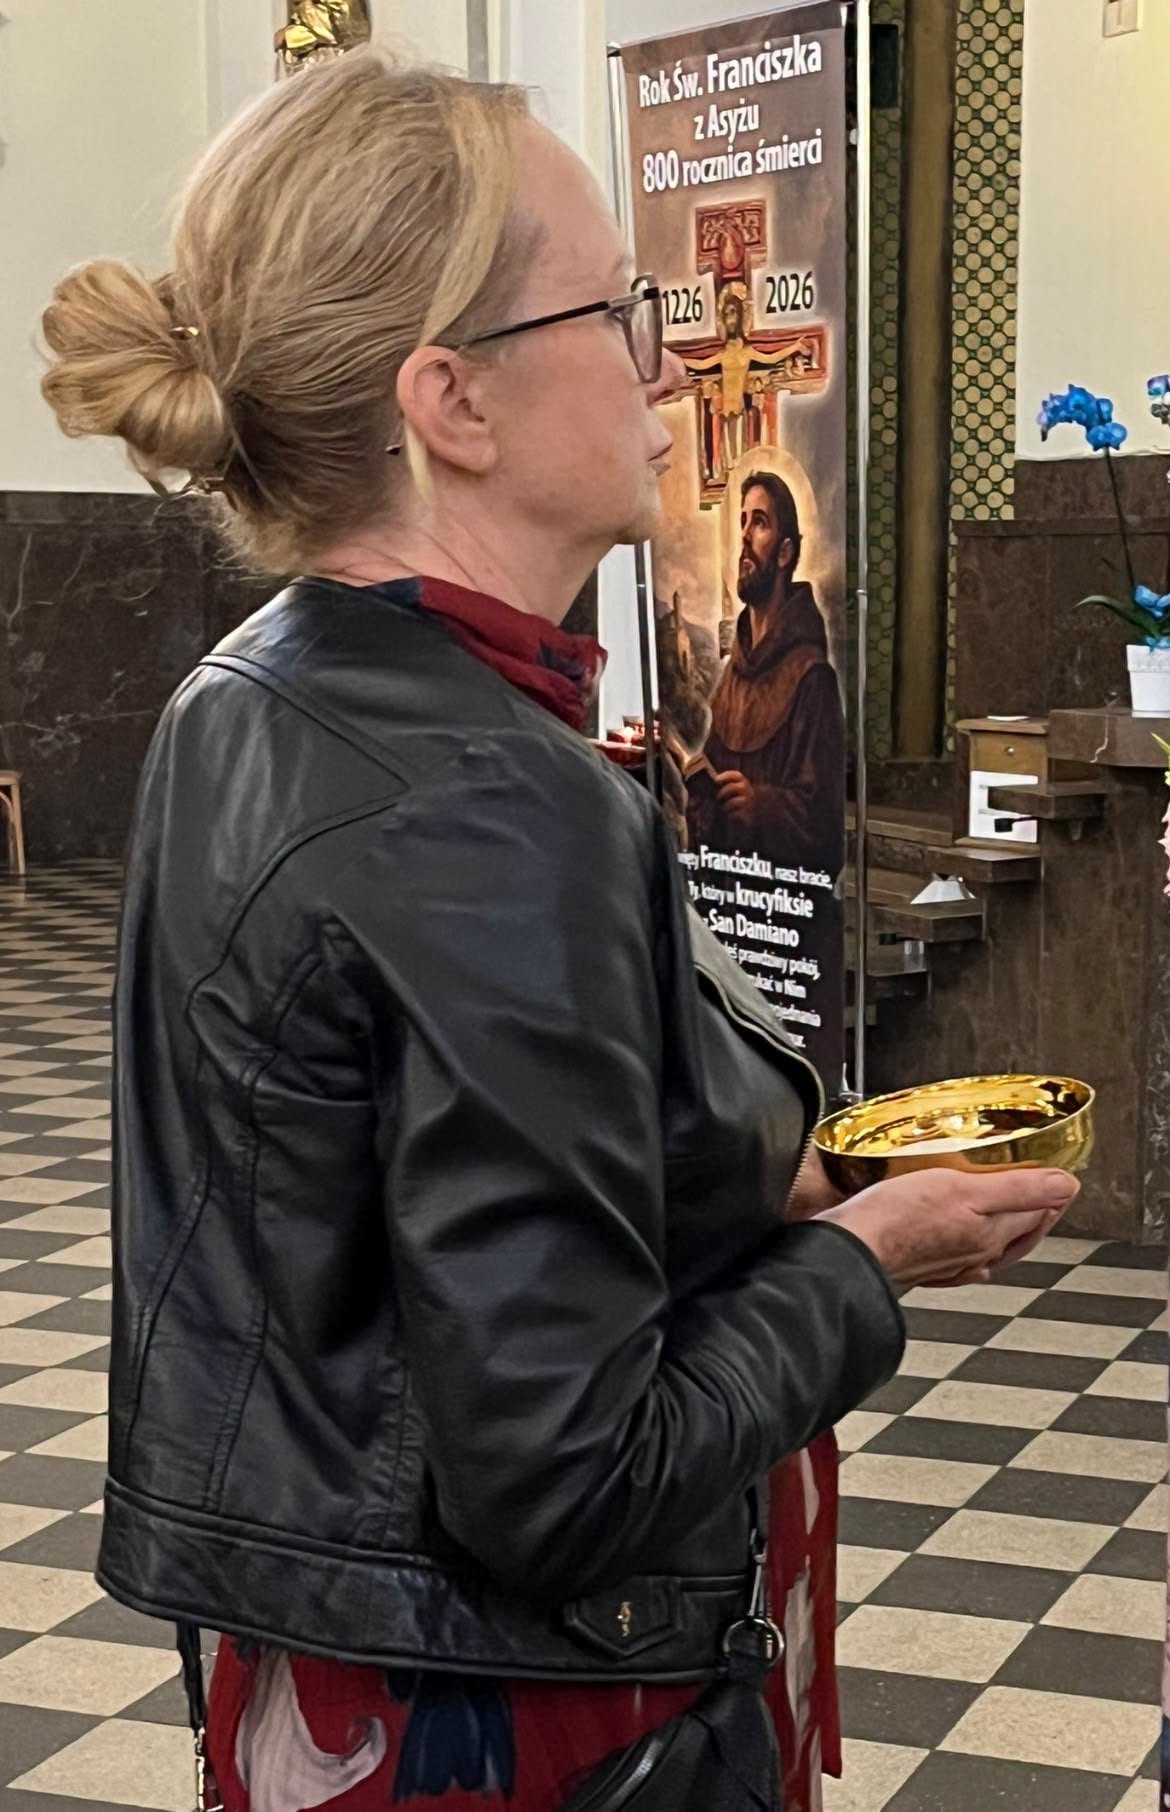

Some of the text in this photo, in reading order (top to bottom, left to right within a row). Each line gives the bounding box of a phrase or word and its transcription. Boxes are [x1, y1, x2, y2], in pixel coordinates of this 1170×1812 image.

[639, 34, 822, 107] Rok Św. Franciszka
[694, 98, 759, 147] z Asyżu
[642, 128, 822, 193] 800 rocznica śmierci
[662, 286, 703, 325] 1226
[766, 270, 814, 313] 2026
[736, 881, 814, 918] krucyfiksie
[709, 908, 734, 935] San
[736, 913, 800, 947] Damiano
